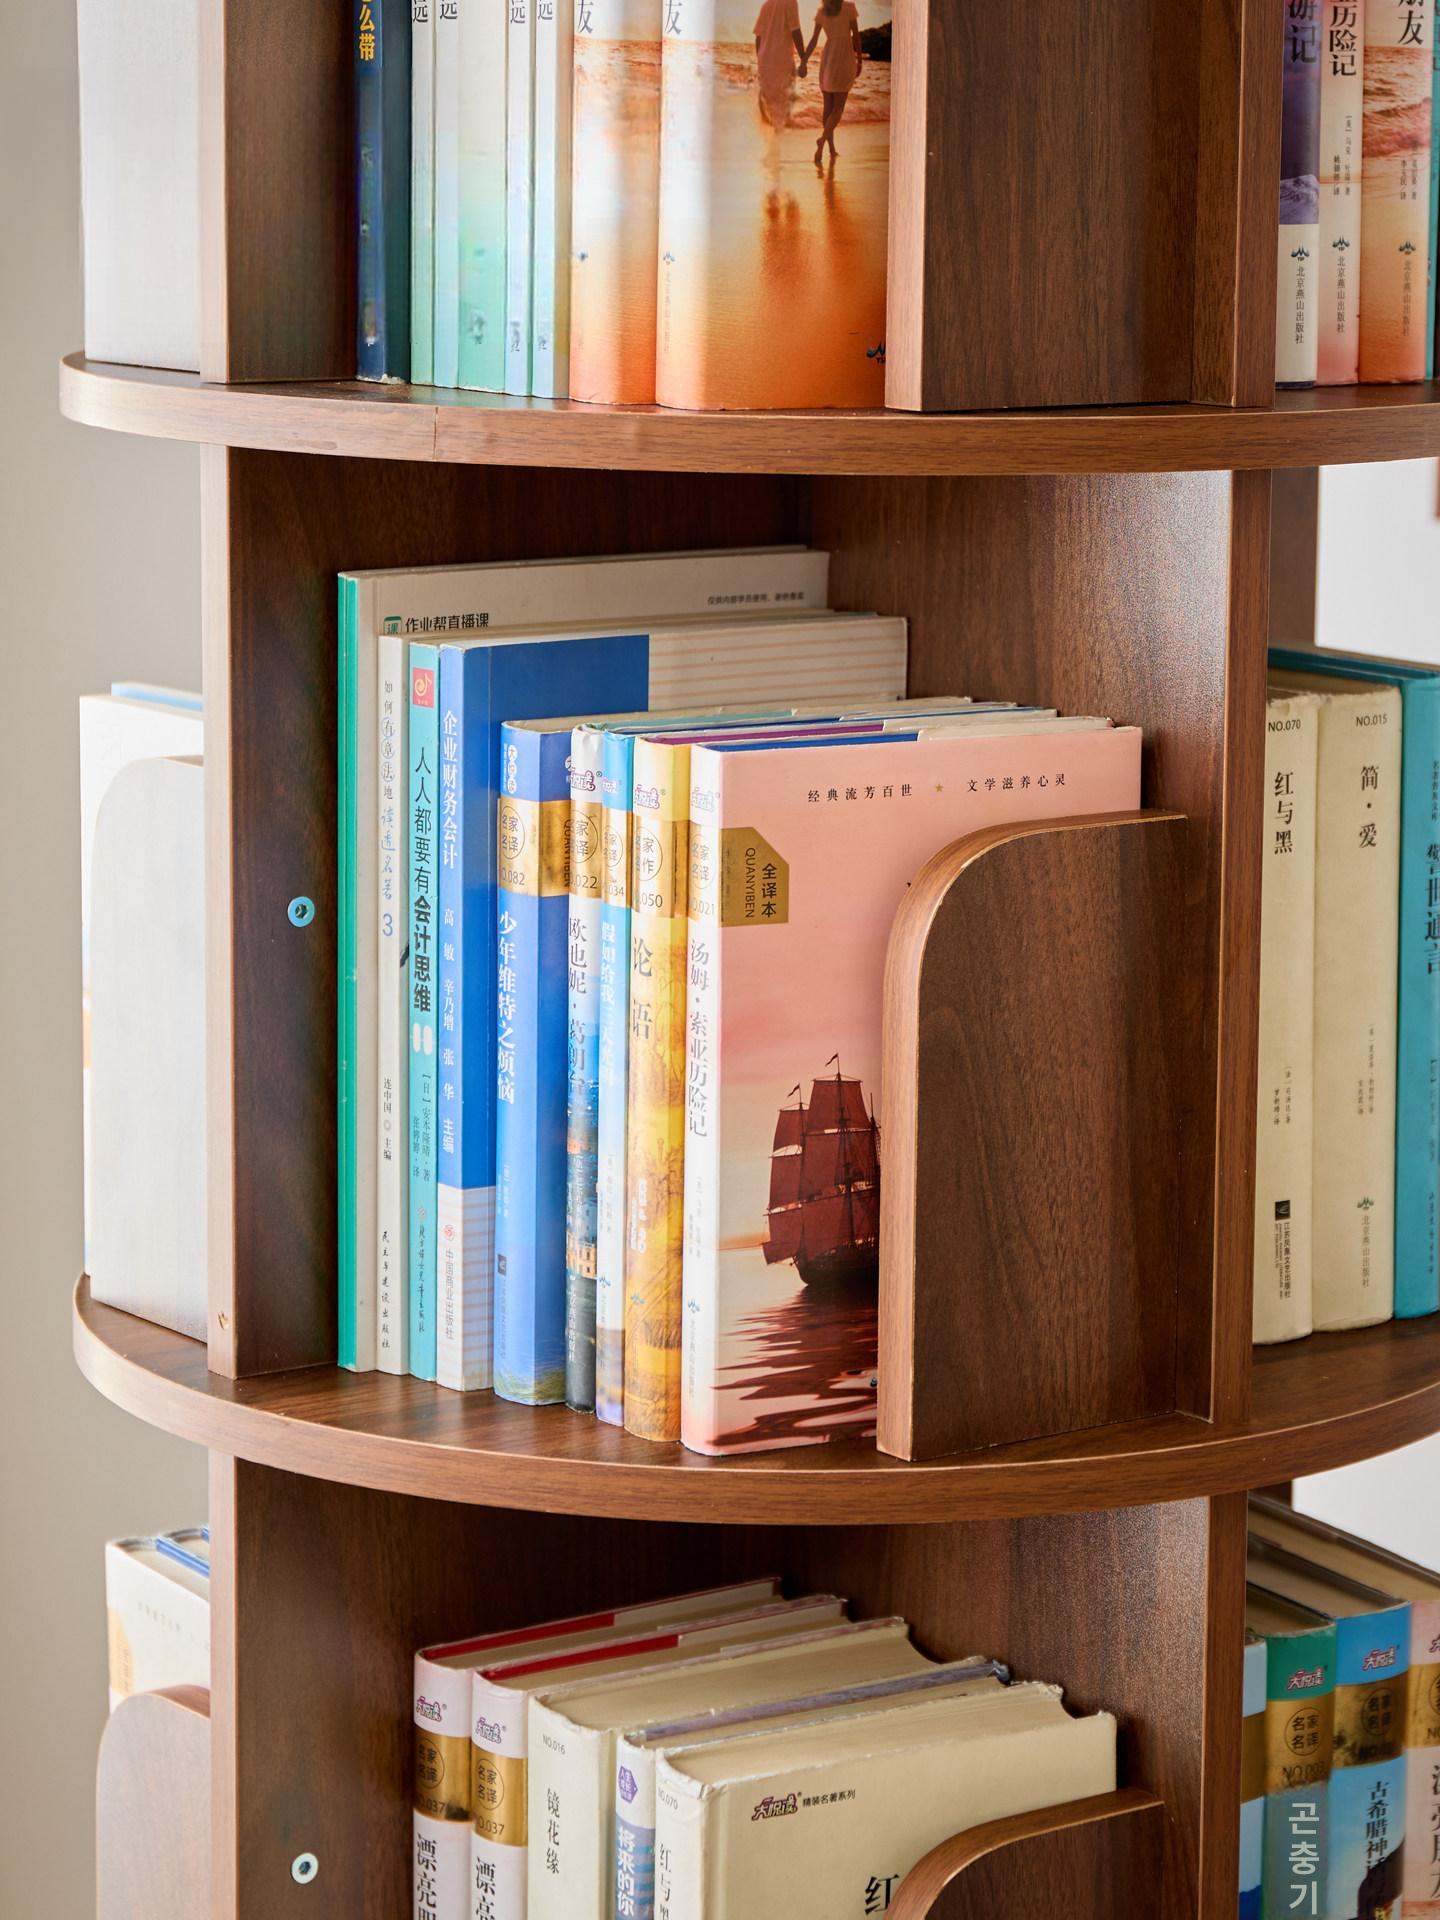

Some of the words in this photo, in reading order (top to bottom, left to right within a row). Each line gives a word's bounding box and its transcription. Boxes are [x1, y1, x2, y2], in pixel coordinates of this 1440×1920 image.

[358, 0, 376, 60] 么带
[1329, 0, 1357, 76] 历险记
[1398, 0, 1424, 45] 友
[1295, 266, 1305, 344] 北京燕山出版社
[1336, 255, 1346, 333] 北京燕山出版社
[1268, 719, 1302, 733] NO.070
[1355, 713, 1388, 728] NO.015
[442, 709, 458, 869] 企业财务会计
[807, 783, 913, 803] 经典流芳百世
[966, 773, 1066, 793] 文学滋养心灵
[1274, 771, 1295, 855] 红与黑
[414, 746, 432, 1013] 人人都要有会计思维
[745, 848, 756, 918] QUANYIBEN
[761, 863, 778, 918] 全译本
[382, 912, 393, 937] 3
[632, 937, 653, 1040] 论语
[617, 1827, 635, 1917] 将来的你
[864, 1873, 899, 1915] 红
